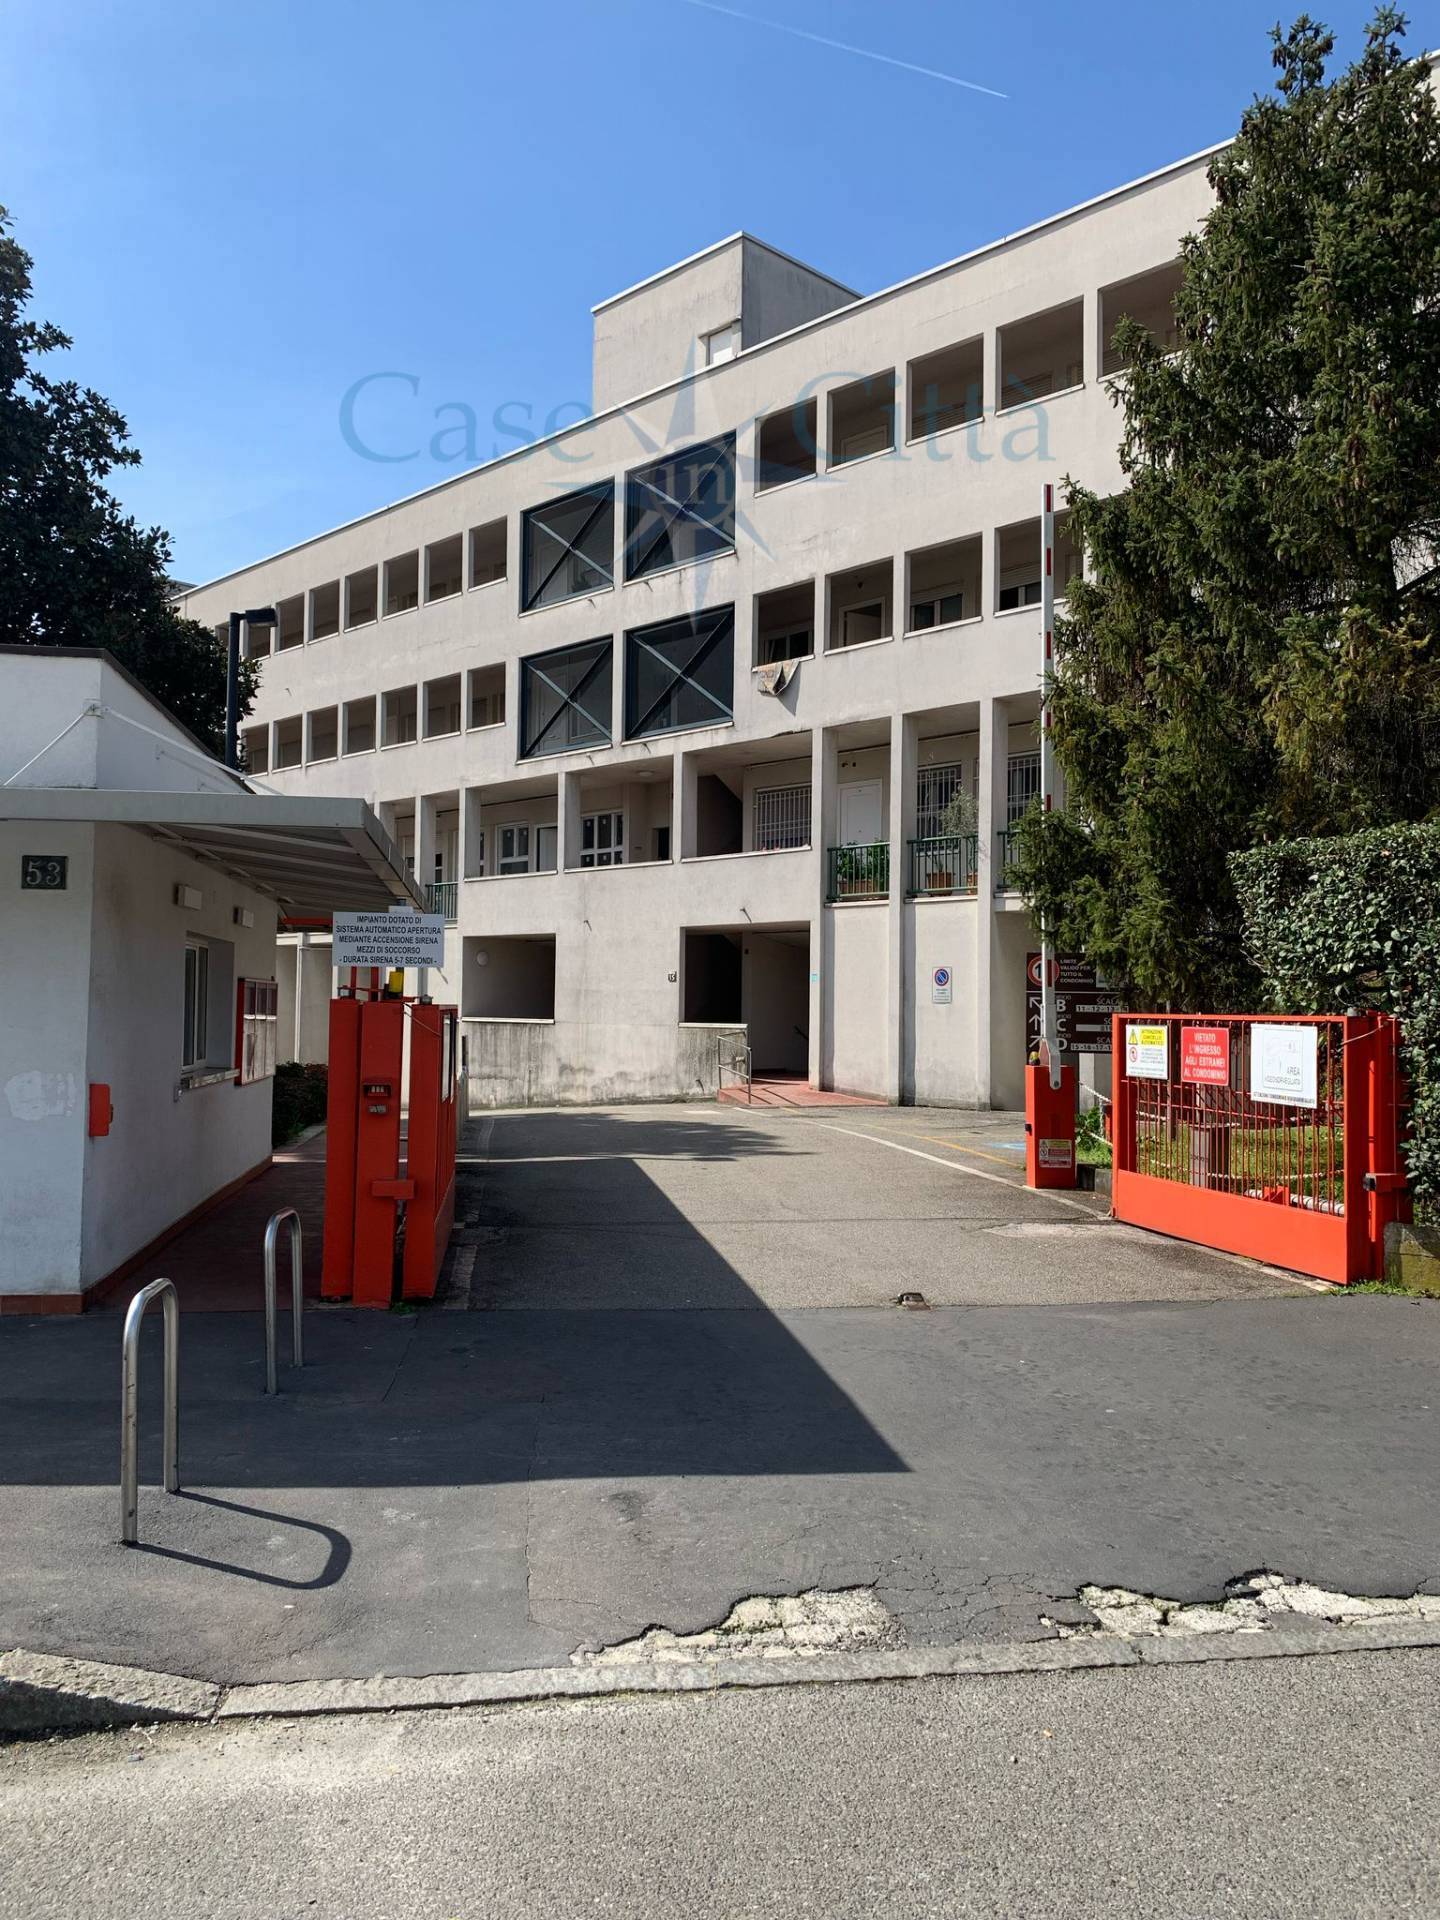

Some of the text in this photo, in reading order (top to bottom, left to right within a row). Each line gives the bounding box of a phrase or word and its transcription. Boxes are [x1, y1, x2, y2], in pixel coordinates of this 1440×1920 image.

[26, 860, 60, 886] 53
[357, 916, 387, 924] IMPIANTO
[336, 925, 441, 934] SISTEMA AUTOMATICO APERTURA
[339, 935, 372, 943] MEDIANTE
[373, 936, 413, 944] ACCENSIONE
[384, 946, 421, 954] SOCCORSO
[343, 955, 368, 963] DURATA
[370, 956, 393, 964] SIRENA
[1056, 999, 1066, 1012] B
[1056, 1018, 1066, 1031] C
[1194, 1033, 1216, 1042] VIETATO
[1056, 1038, 1067, 1050] D
[1189, 1044, 1221, 1055] L'INGRESSO
[1185, 1056, 1226, 1068] AGLI ESTRANEI
[1183, 1067, 1226, 1080] AL CONDOMINIO
